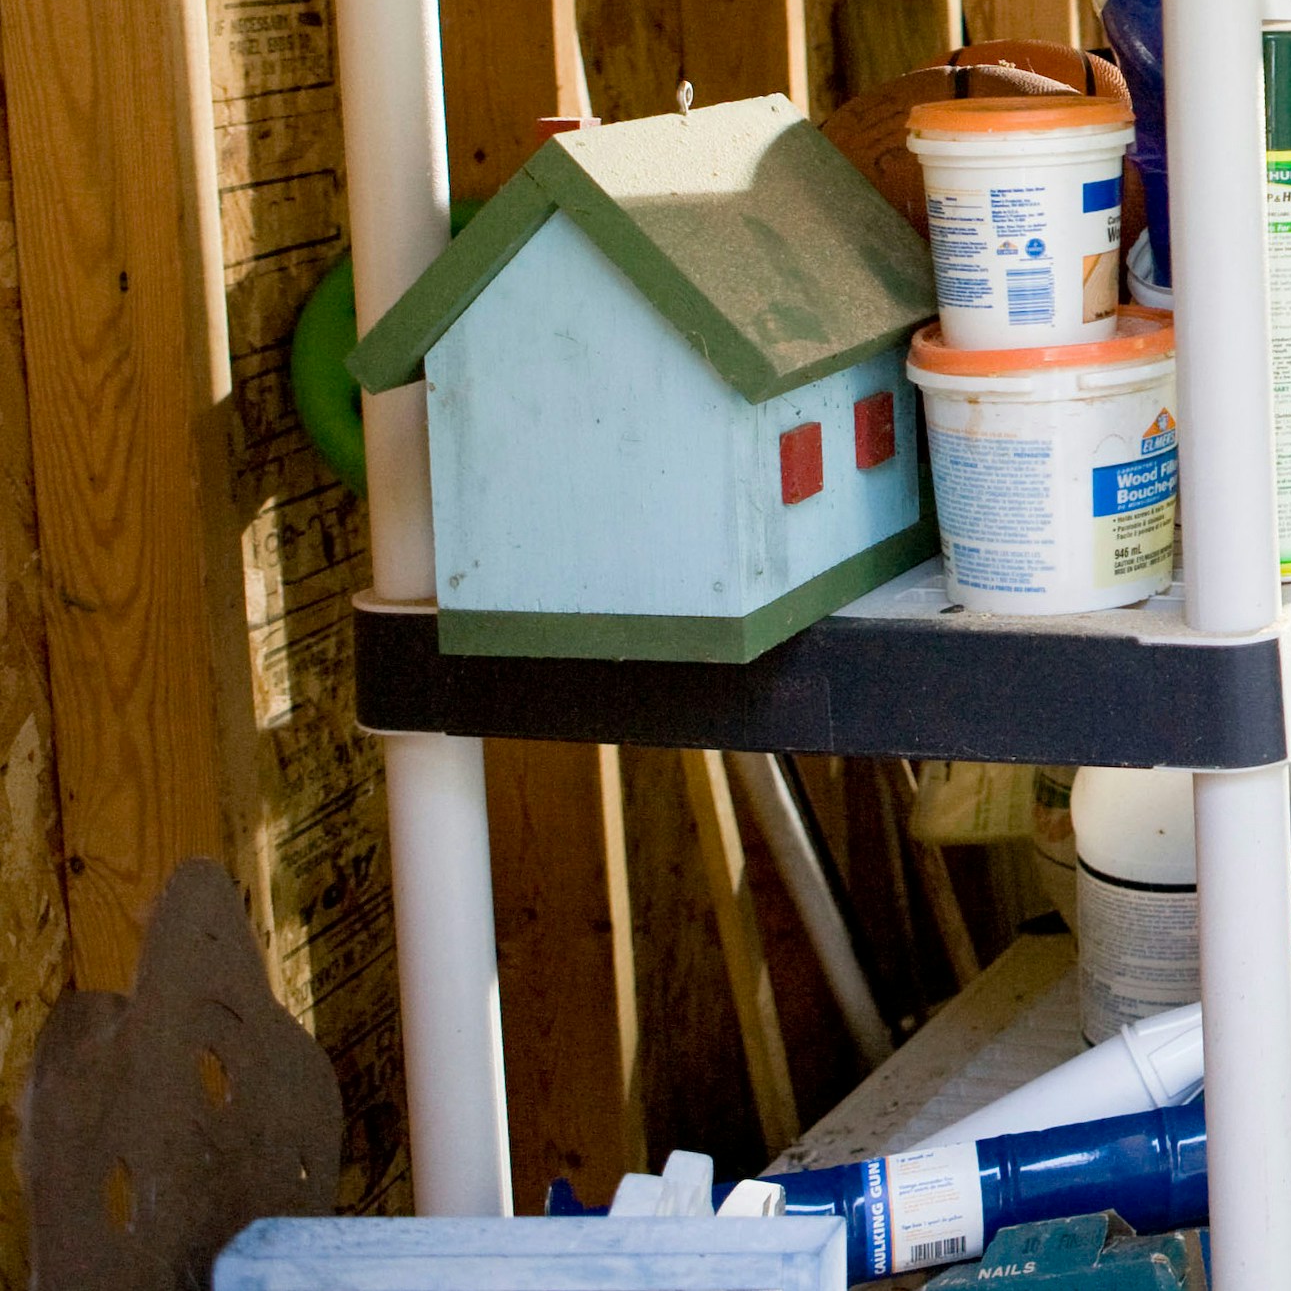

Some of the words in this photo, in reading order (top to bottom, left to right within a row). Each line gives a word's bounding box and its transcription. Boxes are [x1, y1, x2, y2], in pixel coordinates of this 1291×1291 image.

[1117, 466, 1158, 490] Wood
[1114, 547, 1130, 560] 946
[1131, 543, 1142, 556] mL
[868, 1161, 882, 1199] GUN
[871, 1202, 886, 1275] CAULKING
[977, 1261, 1037, 1281] NAILS
